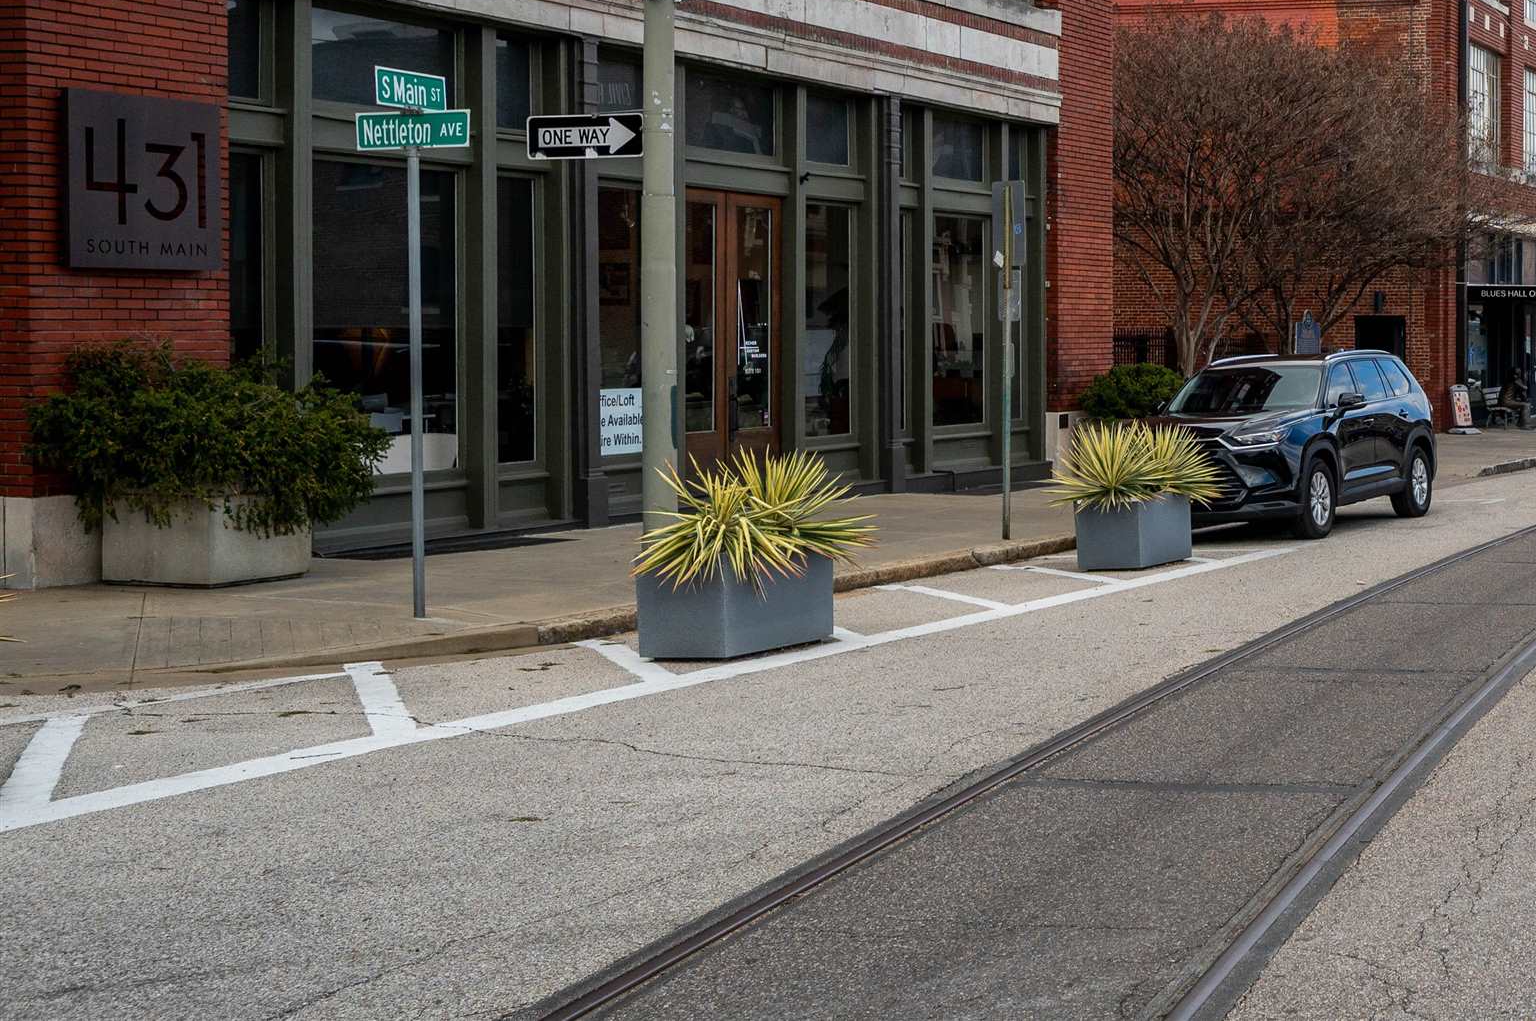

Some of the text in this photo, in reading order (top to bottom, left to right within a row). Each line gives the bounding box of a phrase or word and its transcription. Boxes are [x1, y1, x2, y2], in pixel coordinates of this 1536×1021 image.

[381, 75, 441, 106] S Main ST
[362, 118, 463, 146] Nettleton AVE
[542, 128, 610, 145] ONE WAY
[84, 117, 208, 229] 431
[87, 238, 208, 257] SOUTH MAIN
[1481, 289, 1506, 298] BLUES
[1507, 289, 1528, 298] HALL
[613, 432, 642, 446] Within.
